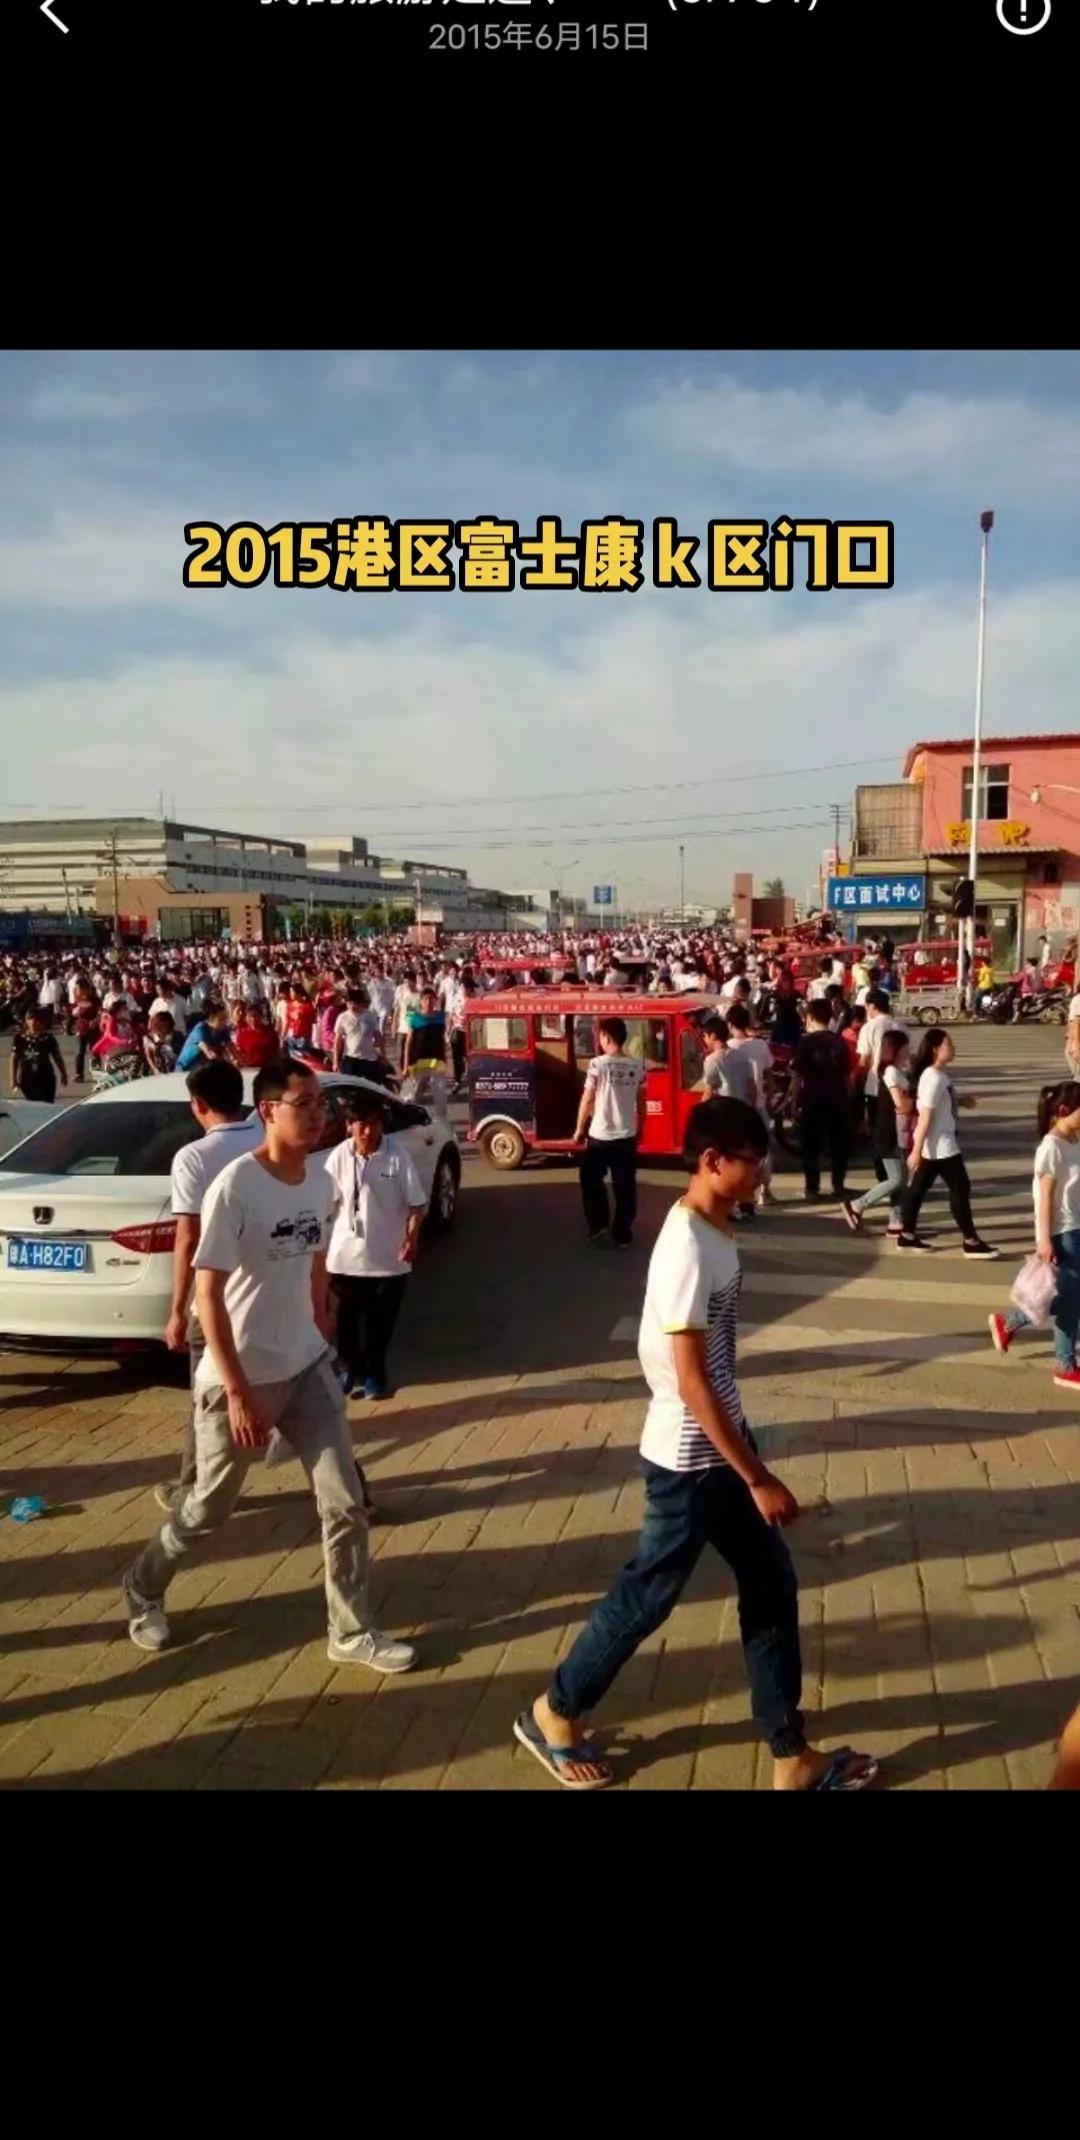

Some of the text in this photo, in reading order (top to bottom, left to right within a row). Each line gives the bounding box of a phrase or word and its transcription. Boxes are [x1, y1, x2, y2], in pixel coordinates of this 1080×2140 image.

[834, 883, 921, 905] F区面试中心
